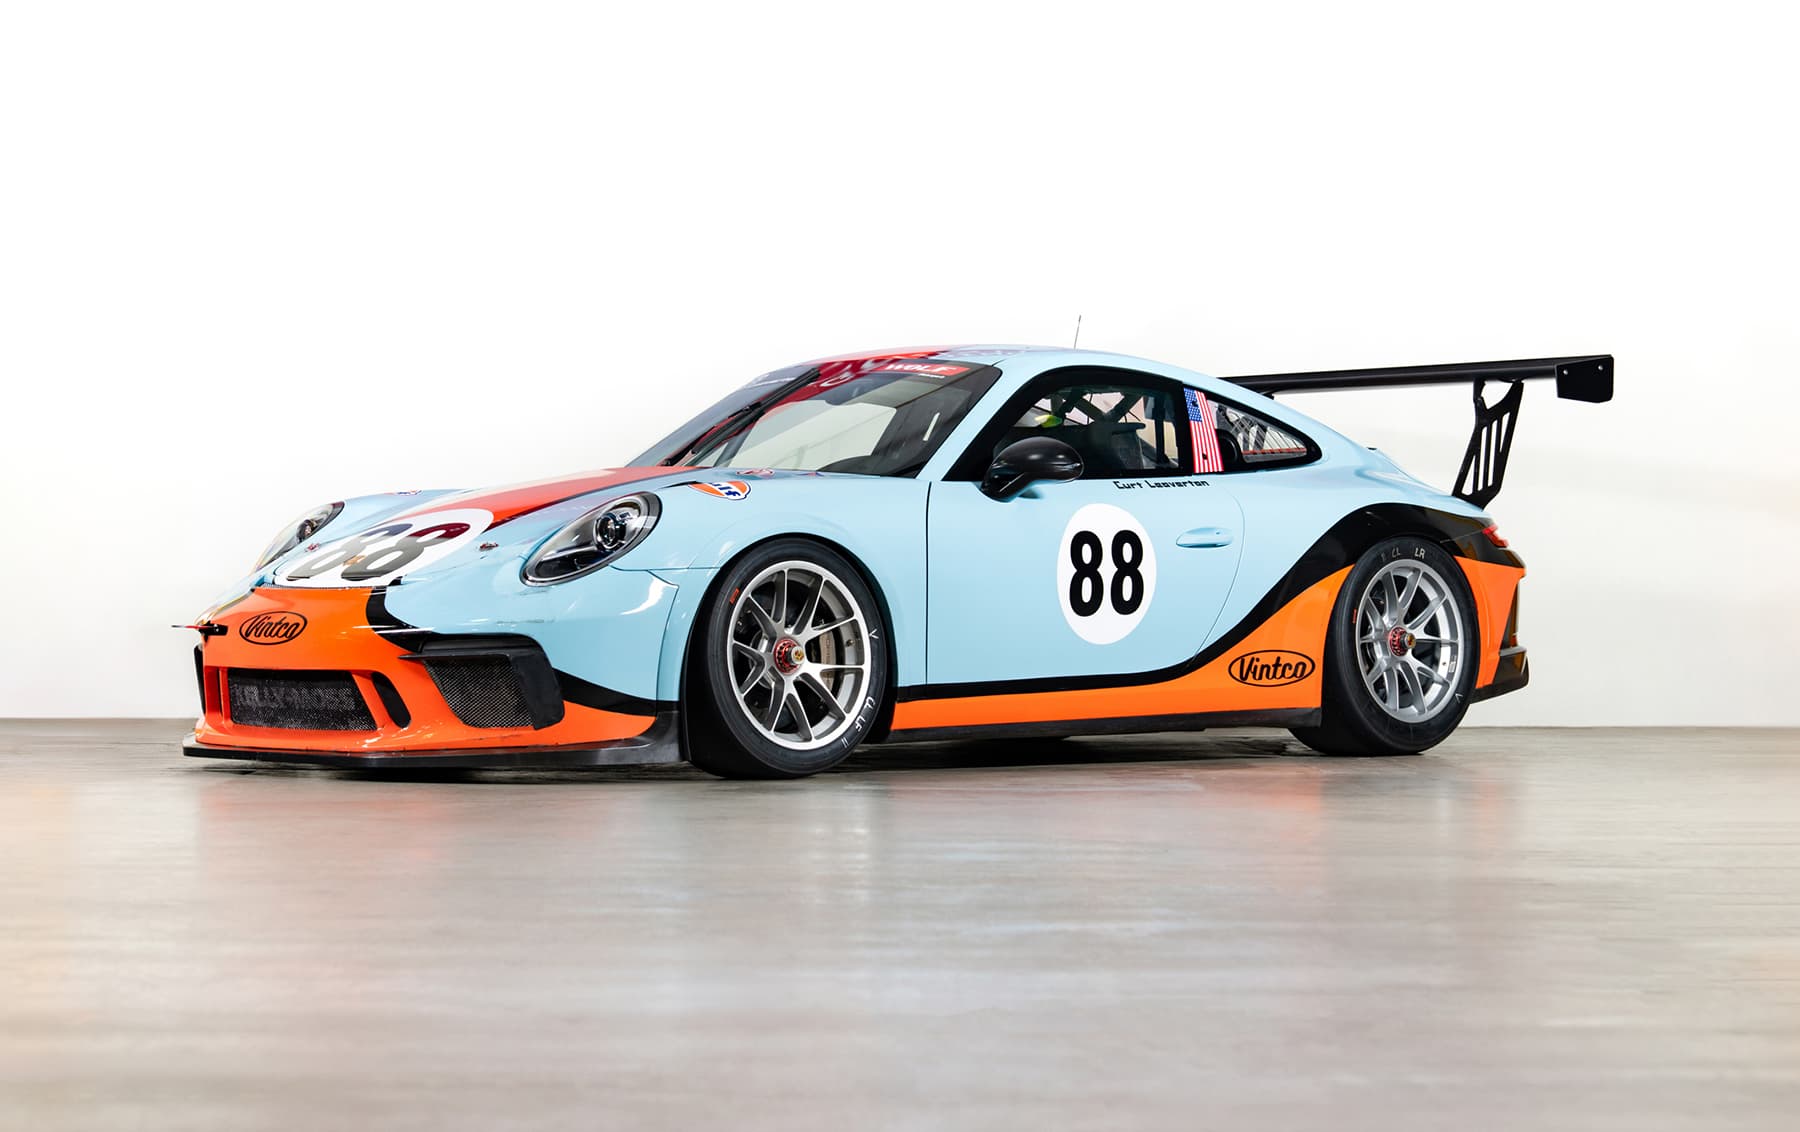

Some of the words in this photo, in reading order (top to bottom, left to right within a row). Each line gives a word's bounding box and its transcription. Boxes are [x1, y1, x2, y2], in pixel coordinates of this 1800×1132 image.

[1112, 480, 1143, 490] Curt
[285, 522, 472, 582] 88
[1069, 529, 1145, 618] 88
[244, 615, 301, 639] Vintco
[1239, 655, 1307, 682] Vintco
